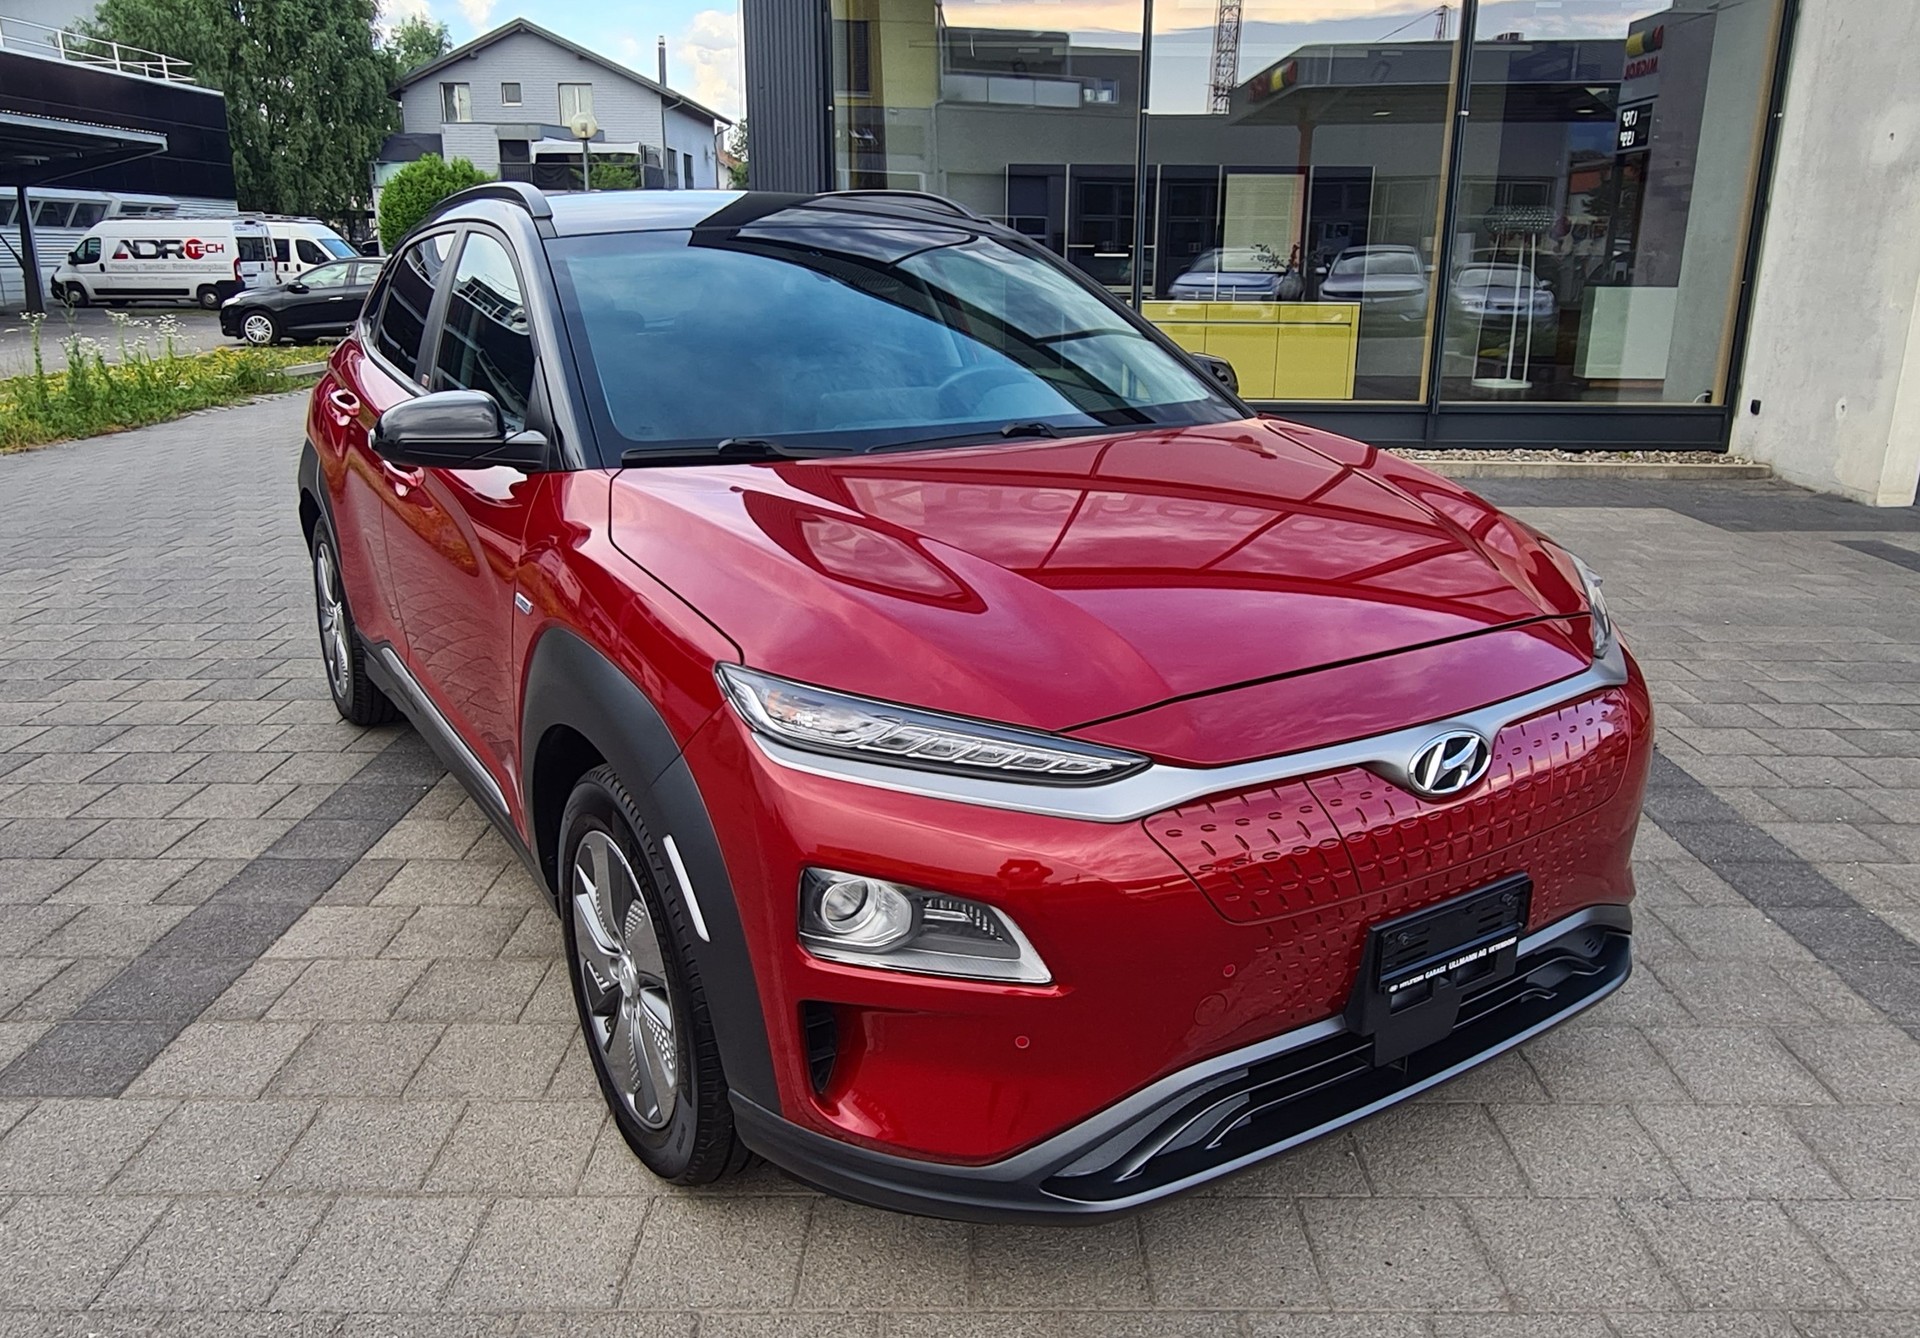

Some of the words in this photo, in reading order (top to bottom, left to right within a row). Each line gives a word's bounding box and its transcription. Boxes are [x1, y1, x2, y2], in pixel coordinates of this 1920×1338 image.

[1425, 965, 1447, 979] GARAGE
[1448, 951, 1478, 970] ULLMANN
[1477, 948, 1487, 958] AG
